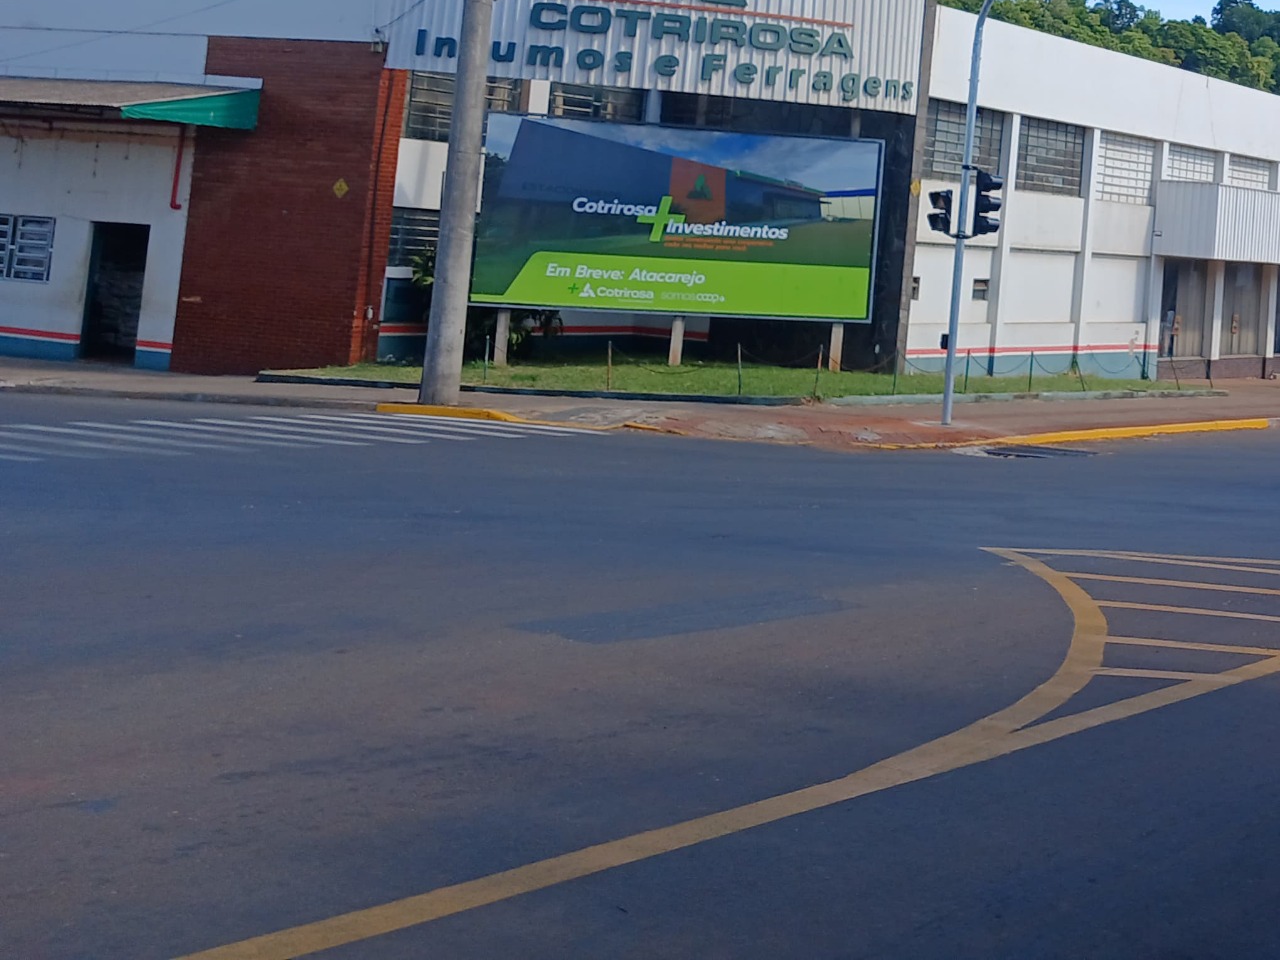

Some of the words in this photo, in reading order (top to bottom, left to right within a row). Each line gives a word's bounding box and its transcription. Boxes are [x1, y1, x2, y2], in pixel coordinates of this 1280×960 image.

[529, 2, 854, 60] COTRIROSA
[415, 28, 633, 73] Inumos
[654, 53, 680, 77] e
[701, 53, 914, 102] Ferragens
[572, 196, 657, 218] Cotrirosa
[666, 218, 790, 241] Investimentos
[545, 262, 572, 278] Em
[574, 264, 625, 281] Breve:
[628, 267, 706, 288] Atacarejo
[597, 286, 655, 300] Cotrirosa
